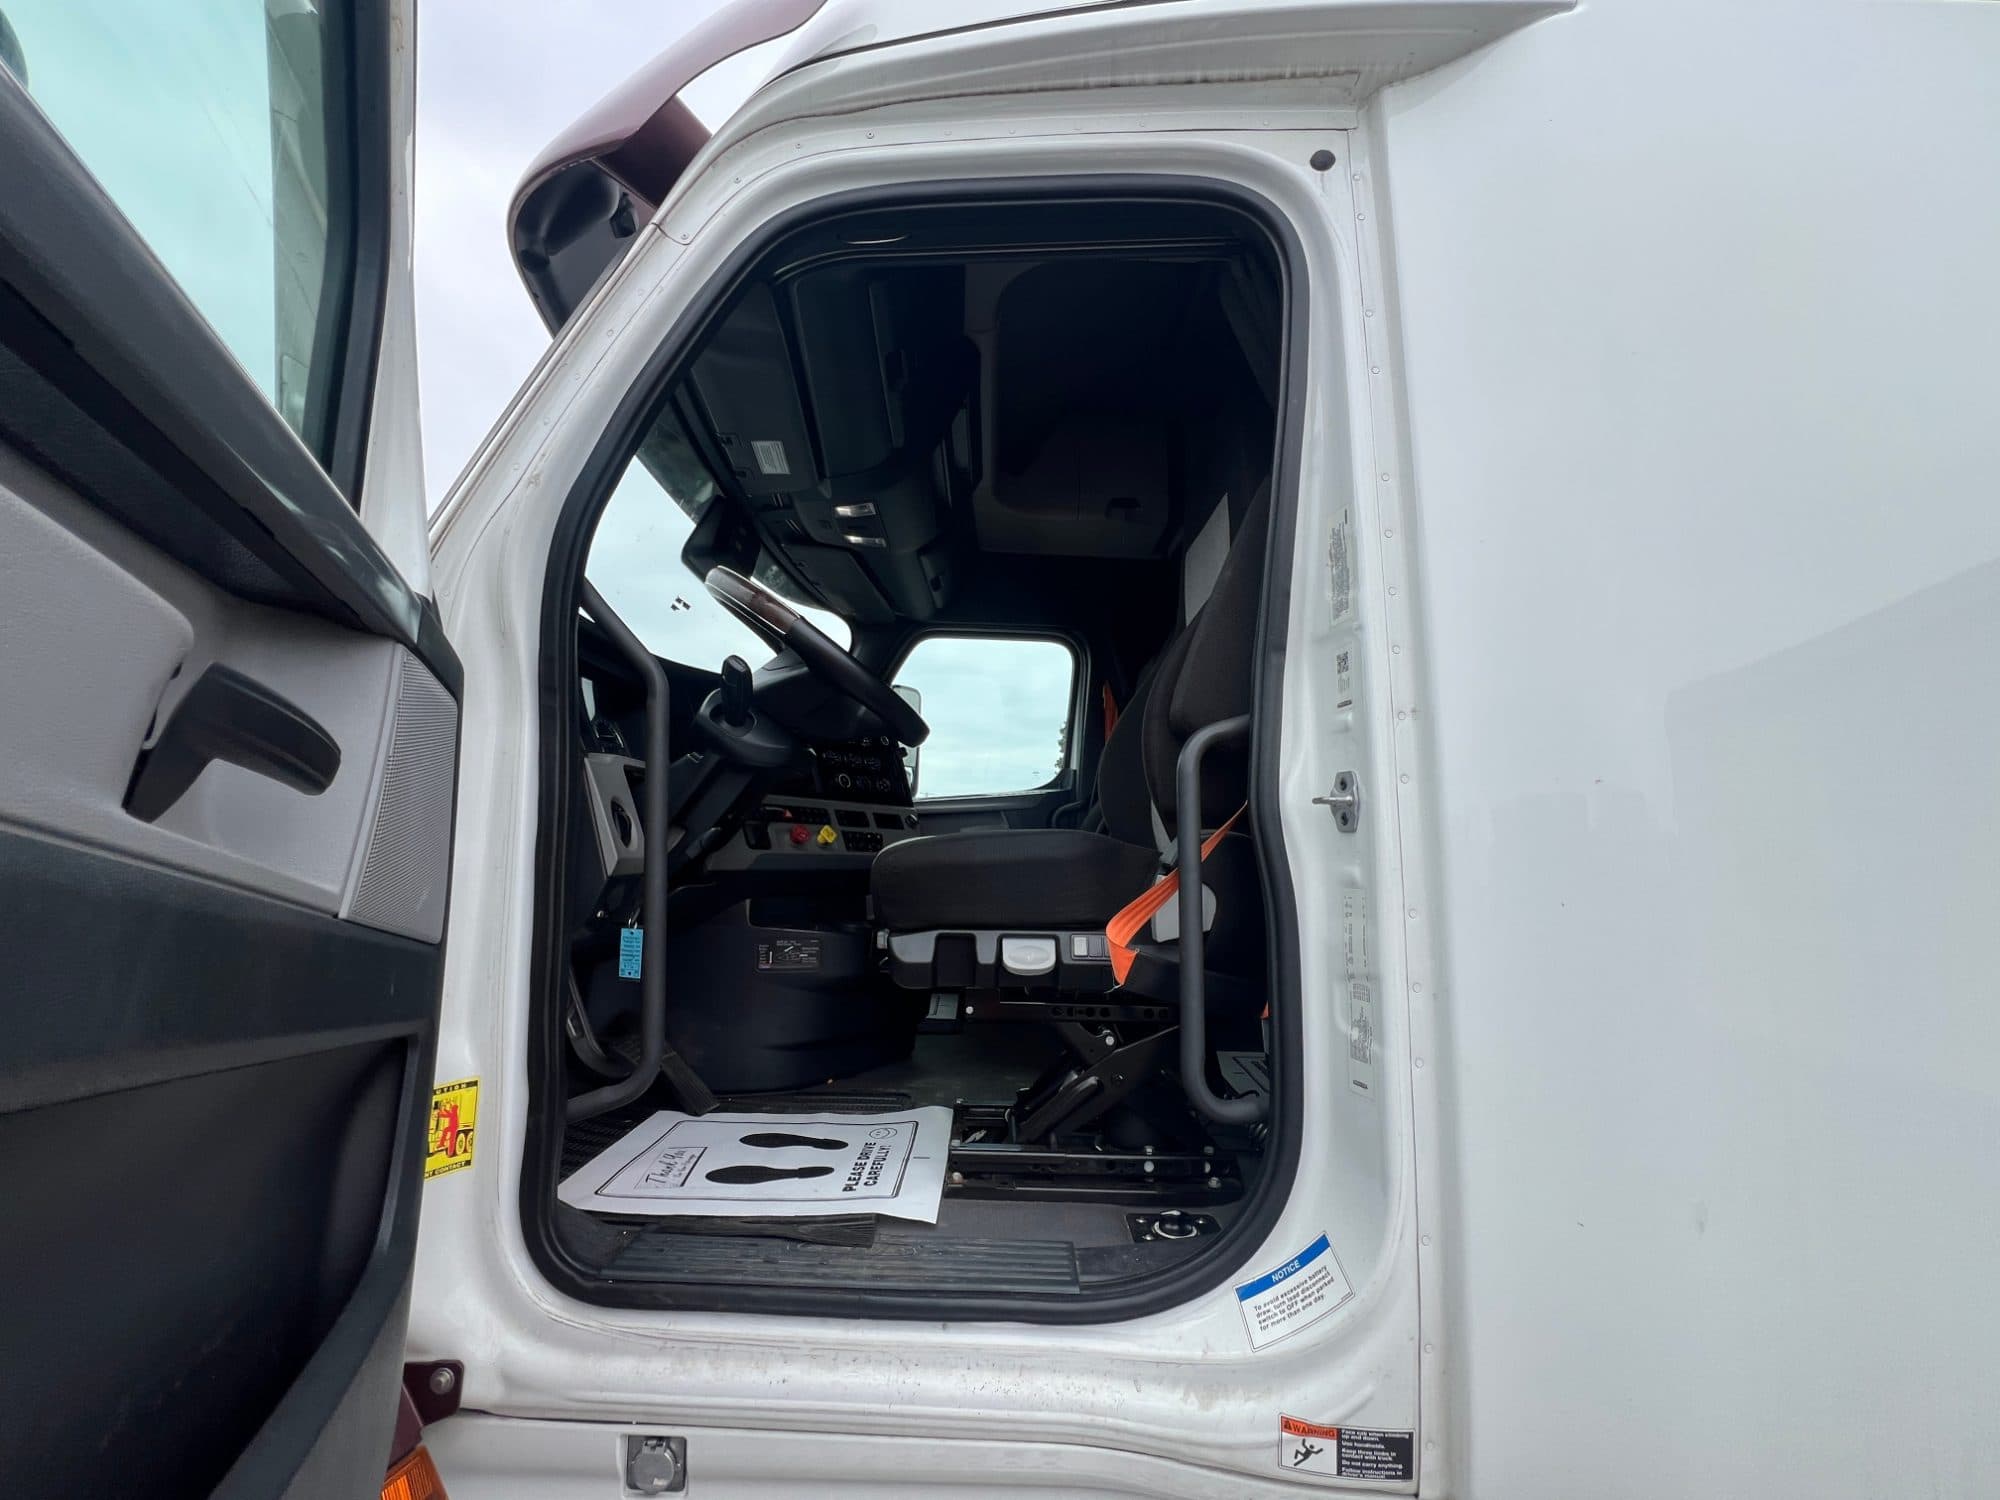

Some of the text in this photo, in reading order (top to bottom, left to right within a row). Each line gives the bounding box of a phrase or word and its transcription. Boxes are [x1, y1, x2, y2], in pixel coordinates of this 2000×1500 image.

[436, 1083, 466, 1094] UTION
[842, 1142, 876, 1192] PLEASE DRIVE
[864, 1145, 892, 1186] CAREFULLY!
[1272, 1259, 1300, 1283] NOTICE
[1286, 1300, 1298, 1311] OFF
[1290, 1422, 1335, 1437] WARNING
